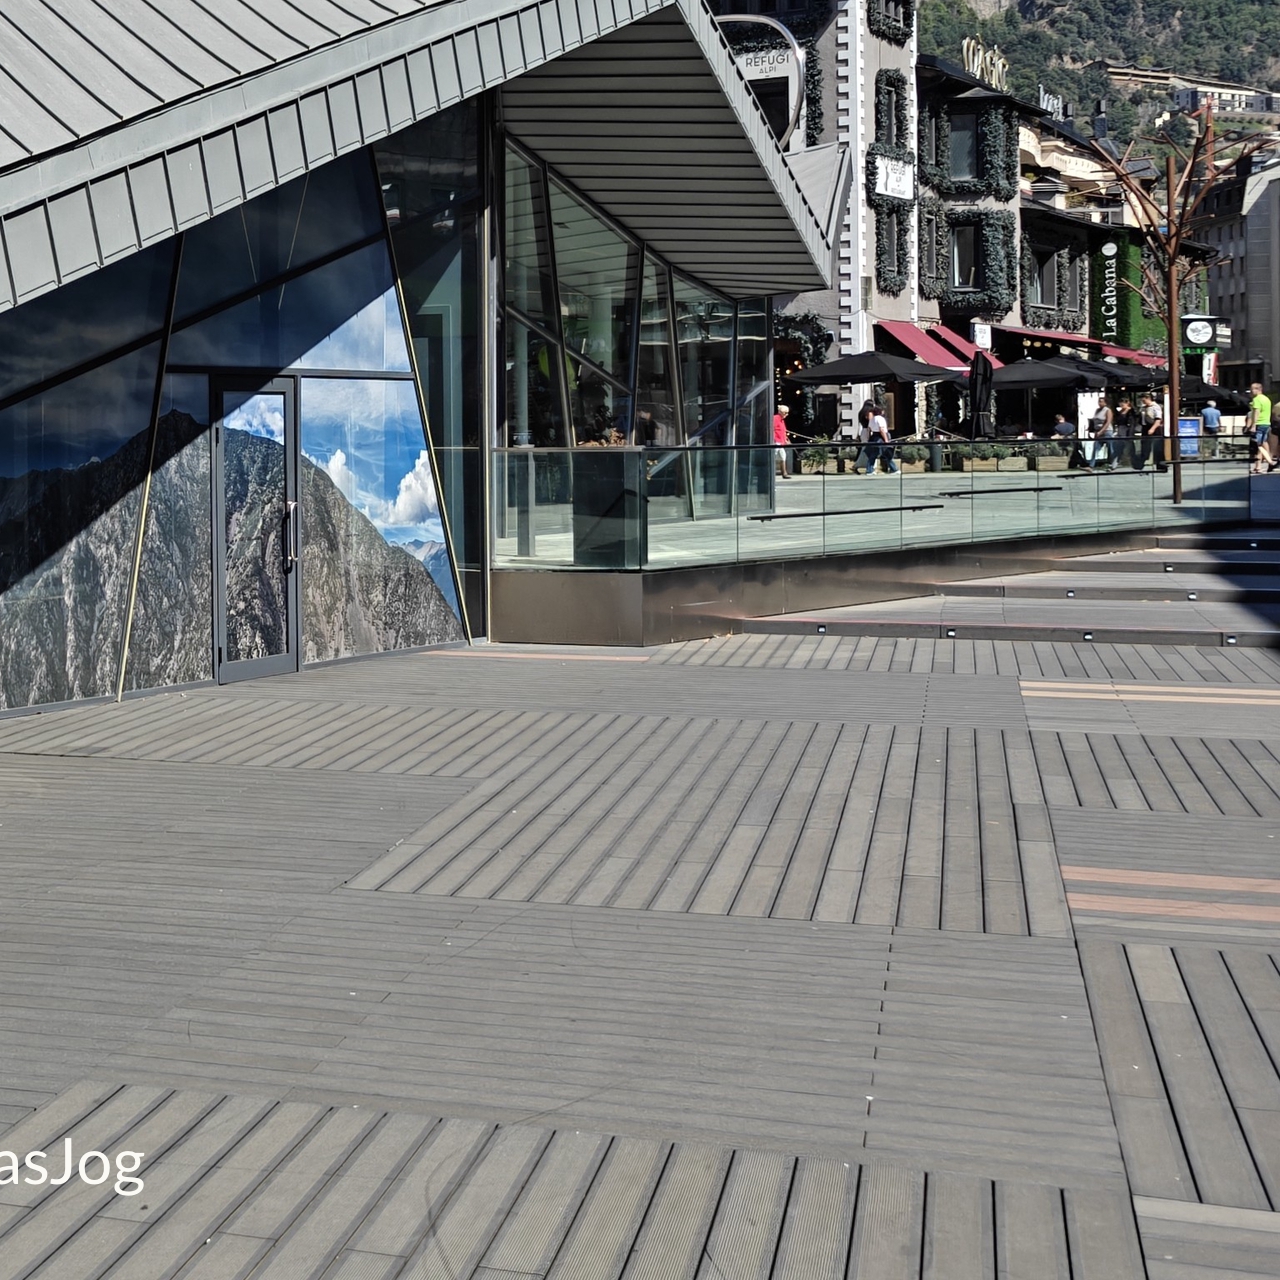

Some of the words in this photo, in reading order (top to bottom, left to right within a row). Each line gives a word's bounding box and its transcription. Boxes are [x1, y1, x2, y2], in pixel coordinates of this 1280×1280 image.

[745, 53, 790, 68] REFUGI
[1101, 258, 1117, 316] Cabana
[1102, 318, 1117, 337] La
